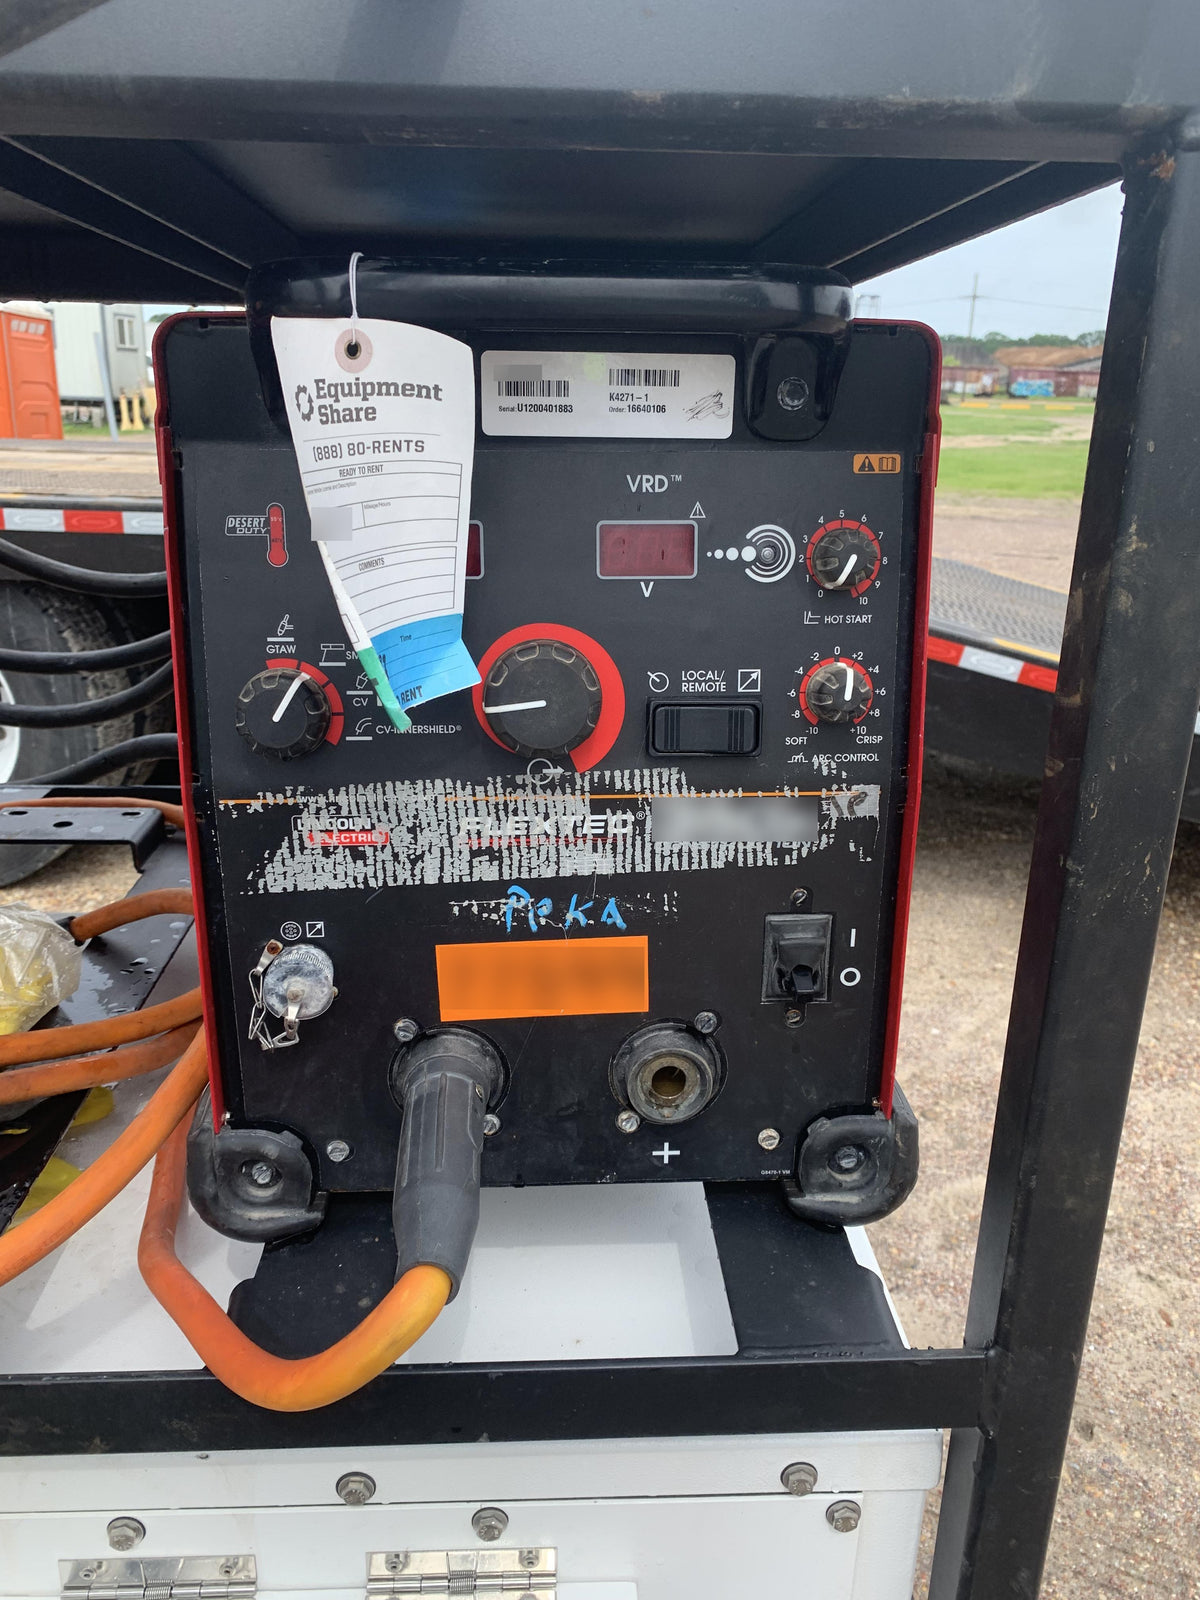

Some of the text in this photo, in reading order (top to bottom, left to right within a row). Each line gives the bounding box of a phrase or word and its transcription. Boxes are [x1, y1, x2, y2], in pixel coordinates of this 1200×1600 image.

[314, 377, 443, 401] Equipment
[517, 403, 573, 413] U1200401883
[627, 404, 666, 413] 16640106
[318, 404, 377, 425] Share
[312, 440, 425, 462] (888) 80-RENTS
[339, 464, 384, 478] READY TO RENT
[839, 510, 845, 518] 5
[861, 514, 867, 522] 6
[228, 517, 266, 528] DESERT
[818, 515, 825, 524] 4
[802, 535, 809, 543] 3
[878, 532, 884, 540] 7
[798, 555, 805, 563] 2
[882, 557, 888, 565] 8
[358, 557, 385, 572] COMMENTS
[640, 581, 654, 598] V
[874, 581, 881, 589] 9
[817, 590, 824, 598] 0
[858, 597, 868, 605] 10
[824, 614, 873, 624] HOT START
[400, 634, 412, 642] Time
[266, 645, 296, 654] GTAW
[834, 646, 841, 655] 0
[810, 652, 820, 661] -2
[851, 651, 864, 660] +2
[794, 666, 804, 675] -4
[868, 665, 880, 674] +4
[681, 670, 725, 681] LOCAL/
[681, 682, 726, 692] REMOTE
[874, 687, 886, 696] +6
[401, 685, 422, 705] RENT
[786, 688, 796, 697] -6
[352, 697, 369, 707] CV
[791, 710, 801, 719] -8
[868, 709, 880, 717] +8
[805, 727, 819, 735] -10
[849, 726, 867, 735] +10
[785, 737, 808, 745] SOFT
[856, 735, 883, 744] CRISP
[811, 753, 880, 762] ARC CONTROL
